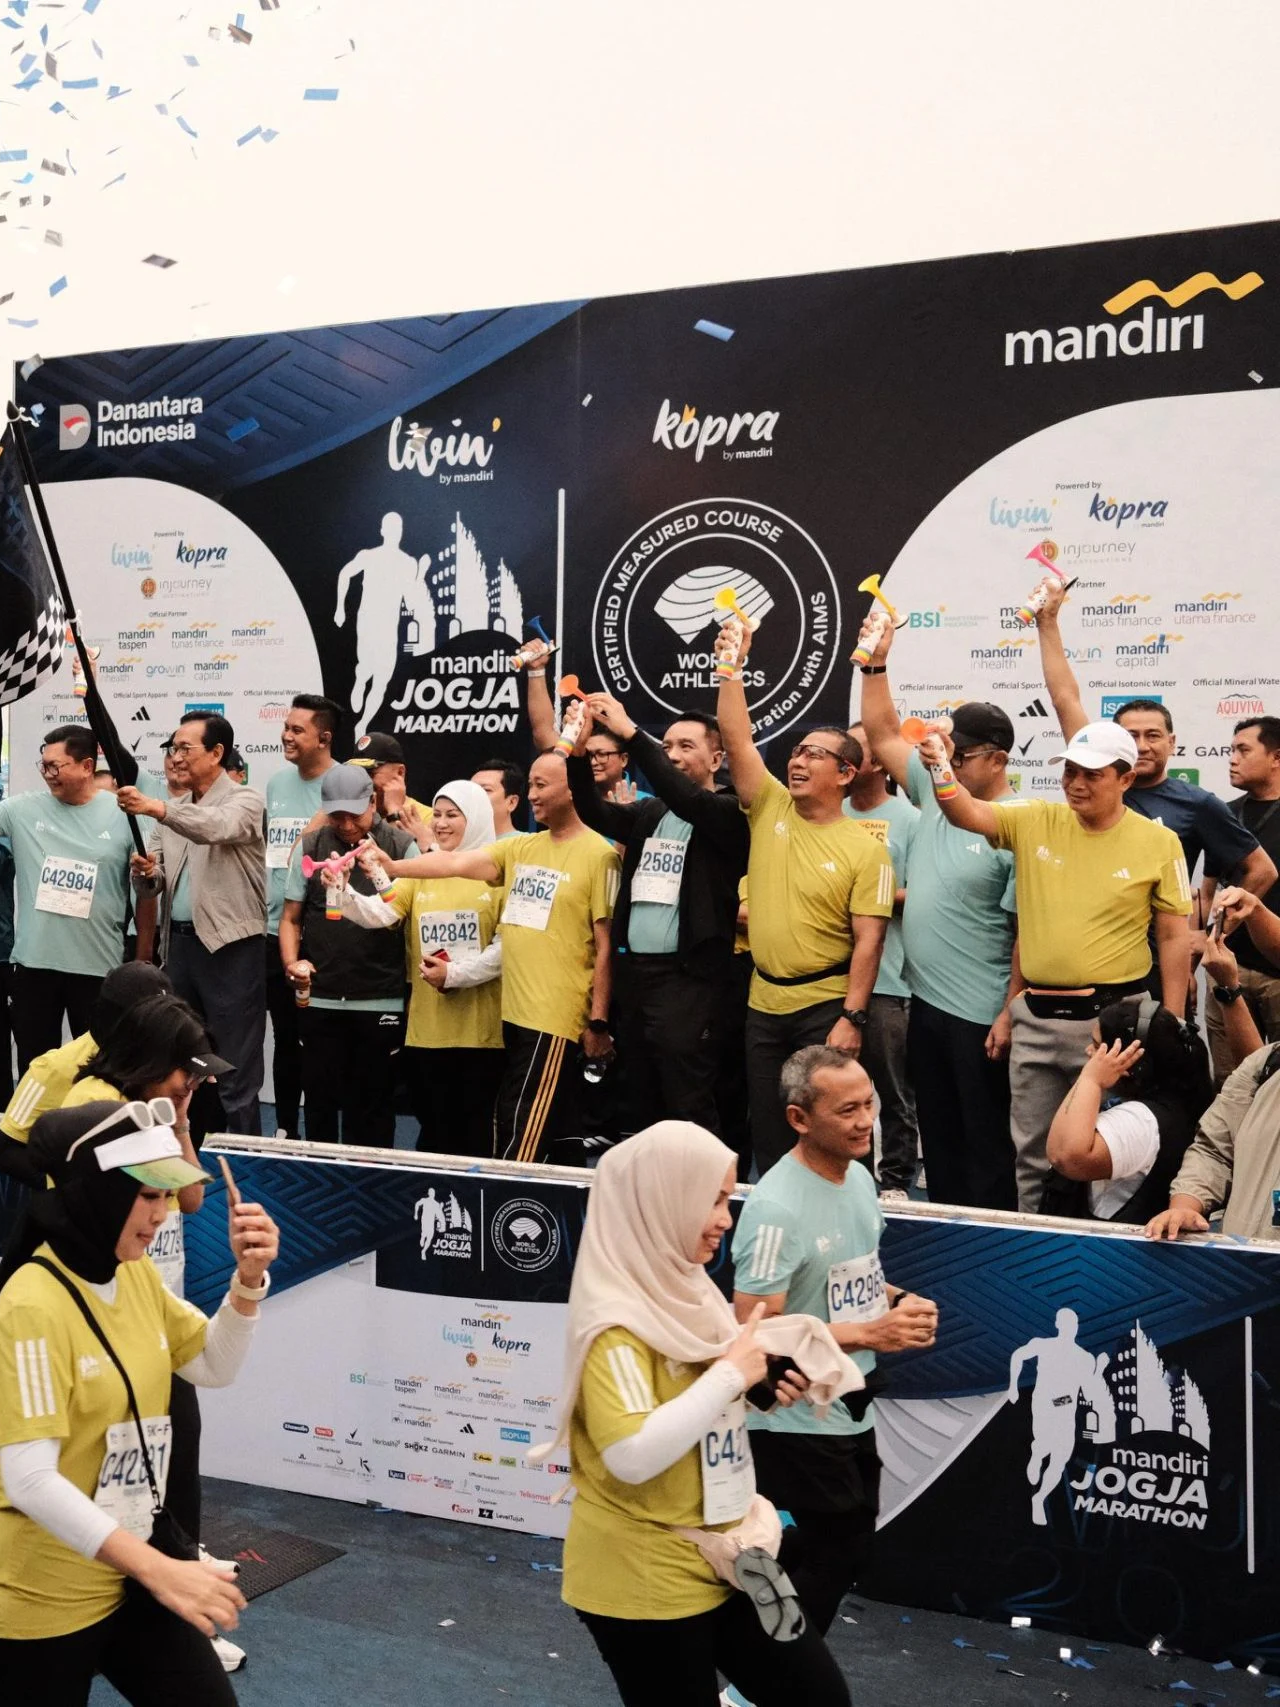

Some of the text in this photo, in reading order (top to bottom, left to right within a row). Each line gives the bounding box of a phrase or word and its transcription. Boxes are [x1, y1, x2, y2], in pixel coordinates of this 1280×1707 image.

[1005, 306, 1204, 366] mandiri
[97, 396, 203, 423] Danantara
[97, 421, 196, 448] Indonesia
[723, 446, 773, 461] by mandiri
[440, 469, 494, 487] by mandiri
[1055, 481, 1101, 491] Powered by
[1063, 541, 1136, 557] injourney
[1076, 581, 1106, 589] Partner
[604, 510, 784, 692] CERTIFIED MEASURED COURSE
[1174, 600, 1228, 612] mandiri
[1082, 603, 1137, 616] mandiri
[909, 612, 940, 629] BSI
[1081, 615, 1162, 627] tunas finance
[1174, 611, 1256, 624] utama finance
[118, 627, 155, 640] mandiri
[171, 627, 208, 639] mandiri
[231, 626, 266, 638] mandiri
[118, 639, 148, 652] taspen
[800, 591, 828, 689] with AIMS
[971, 645, 1022, 659] mandiri
[1116, 643, 1169, 655] mandiri
[99, 662, 134, 673] mandiri
[194, 660, 229, 671] mandiri
[677, 653, 749, 670] WOR
[1115, 656, 1159, 668] capital
[660, 670, 766, 689] ATHLECS
[1088, 680, 1177, 688] Official Isotonic Water
[1192, 677, 1280, 687] Official Mineral Wate
[992, 682, 1042, 691] Official Sport
[133, 691, 147, 699] Sport
[147, 690, 168, 699] Apparel
[390, 677, 520, 710] JOGJA
[1216, 701, 1265, 714] AQUVIVA
[394, 713, 518, 734] MARATHON
[245, 744, 283, 754] GARMI
[1194, 746, 1233, 757] GAR
[660, 842, 684, 852] 5K-M
[637, 851, 684, 874] 2588
[41, 866, 93, 892] C42984
[536, 869, 558, 880] 5K-M
[455, 912, 476, 920] 5K-F
[420, 922, 478, 944] C42842
[444, 1231, 472, 1241] mandiri
[432, 1238, 472, 1252] JOGJA
[511, 1246, 541, 1254] ATHLETICS
[433, 1249, 471, 1259] MARATHON
[461, 1315, 501, 1330] mandiri
[349, 1373, 366, 1385] BSI
[394, 1378, 422, 1388] mandiri
[394, 1385, 417, 1395] taspen
[434, 1384, 461, 1395] mandiri
[478, 1390, 504, 1401] mandiri
[523, 1397, 551, 1408] mandiri
[403, 1418, 432, 1428] mandiri
[501, 1430, 530, 1442] ISOPLUS
[431, 1447, 466, 1458] GARMIN
[1112, 1447, 1209, 1477] mandiri
[1070, 1464, 1209, 1509] JOGJA
[1074, 1495, 1207, 1531] MARATHON
